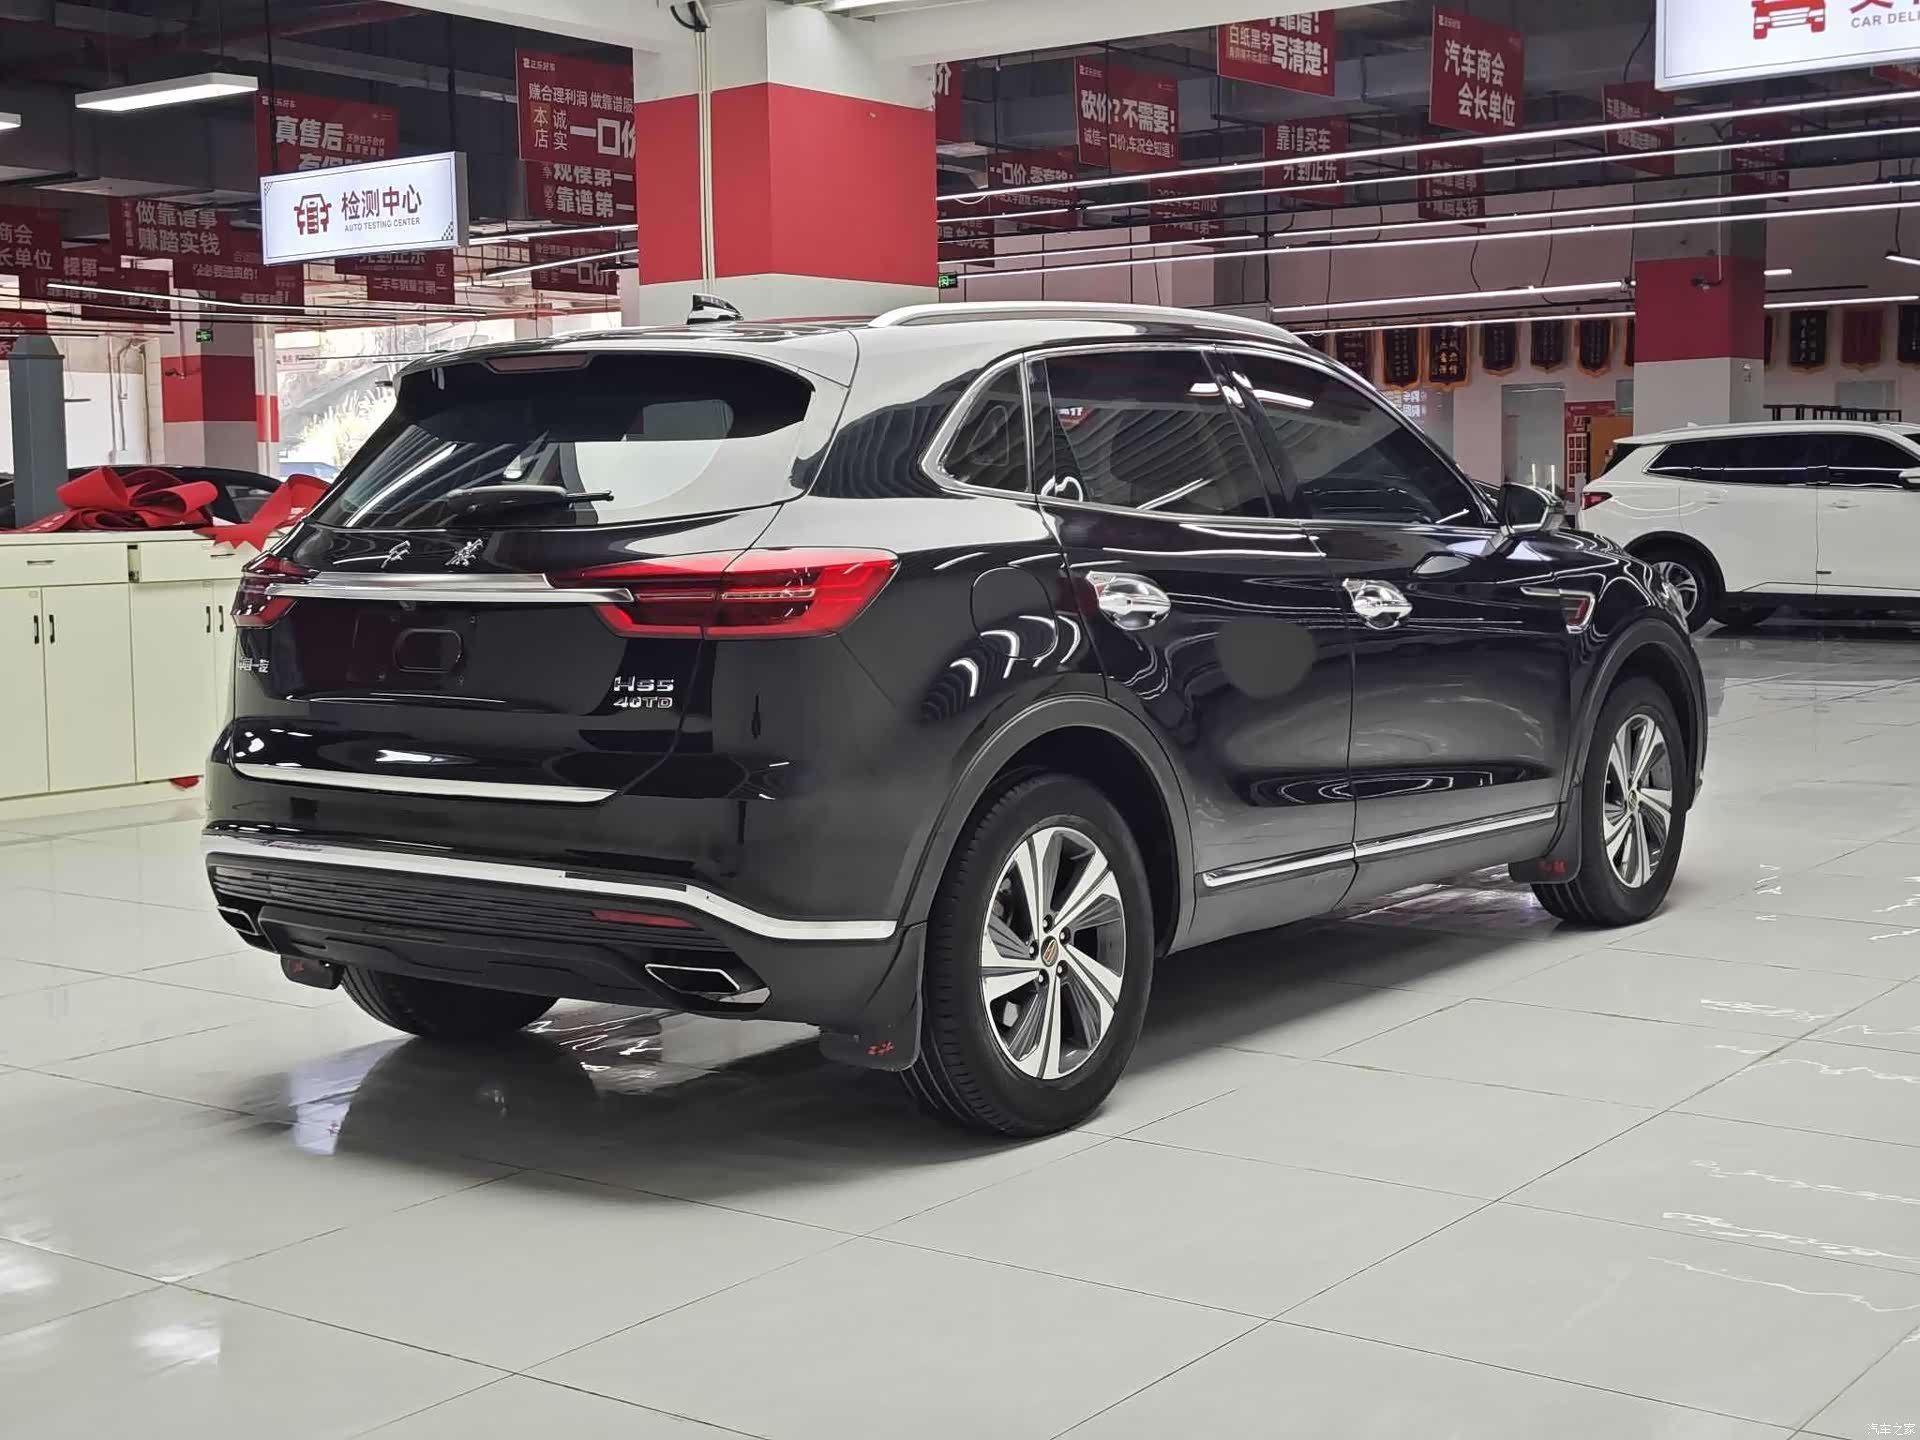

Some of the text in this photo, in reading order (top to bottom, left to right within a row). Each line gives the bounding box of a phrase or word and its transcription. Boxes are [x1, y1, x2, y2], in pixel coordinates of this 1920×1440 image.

[1851, 15, 1882, 29] CAR
[1271, 33, 1328, 77] 写清楚!
[1444, 39, 1506, 88] 汽车商会
[528, 82, 588, 108] 赚合理利润
[1457, 81, 1516, 128] 会长单位
[275, 115, 344, 152] 真售后
[341, 183, 422, 221] 检测中心
[556, 185, 635, 218] 靠谱第一
[344, 217, 421, 232] AUTO TESTING CENTER
[613, 675, 674, 692] HS5
[613, 696, 673, 709] 40TD
